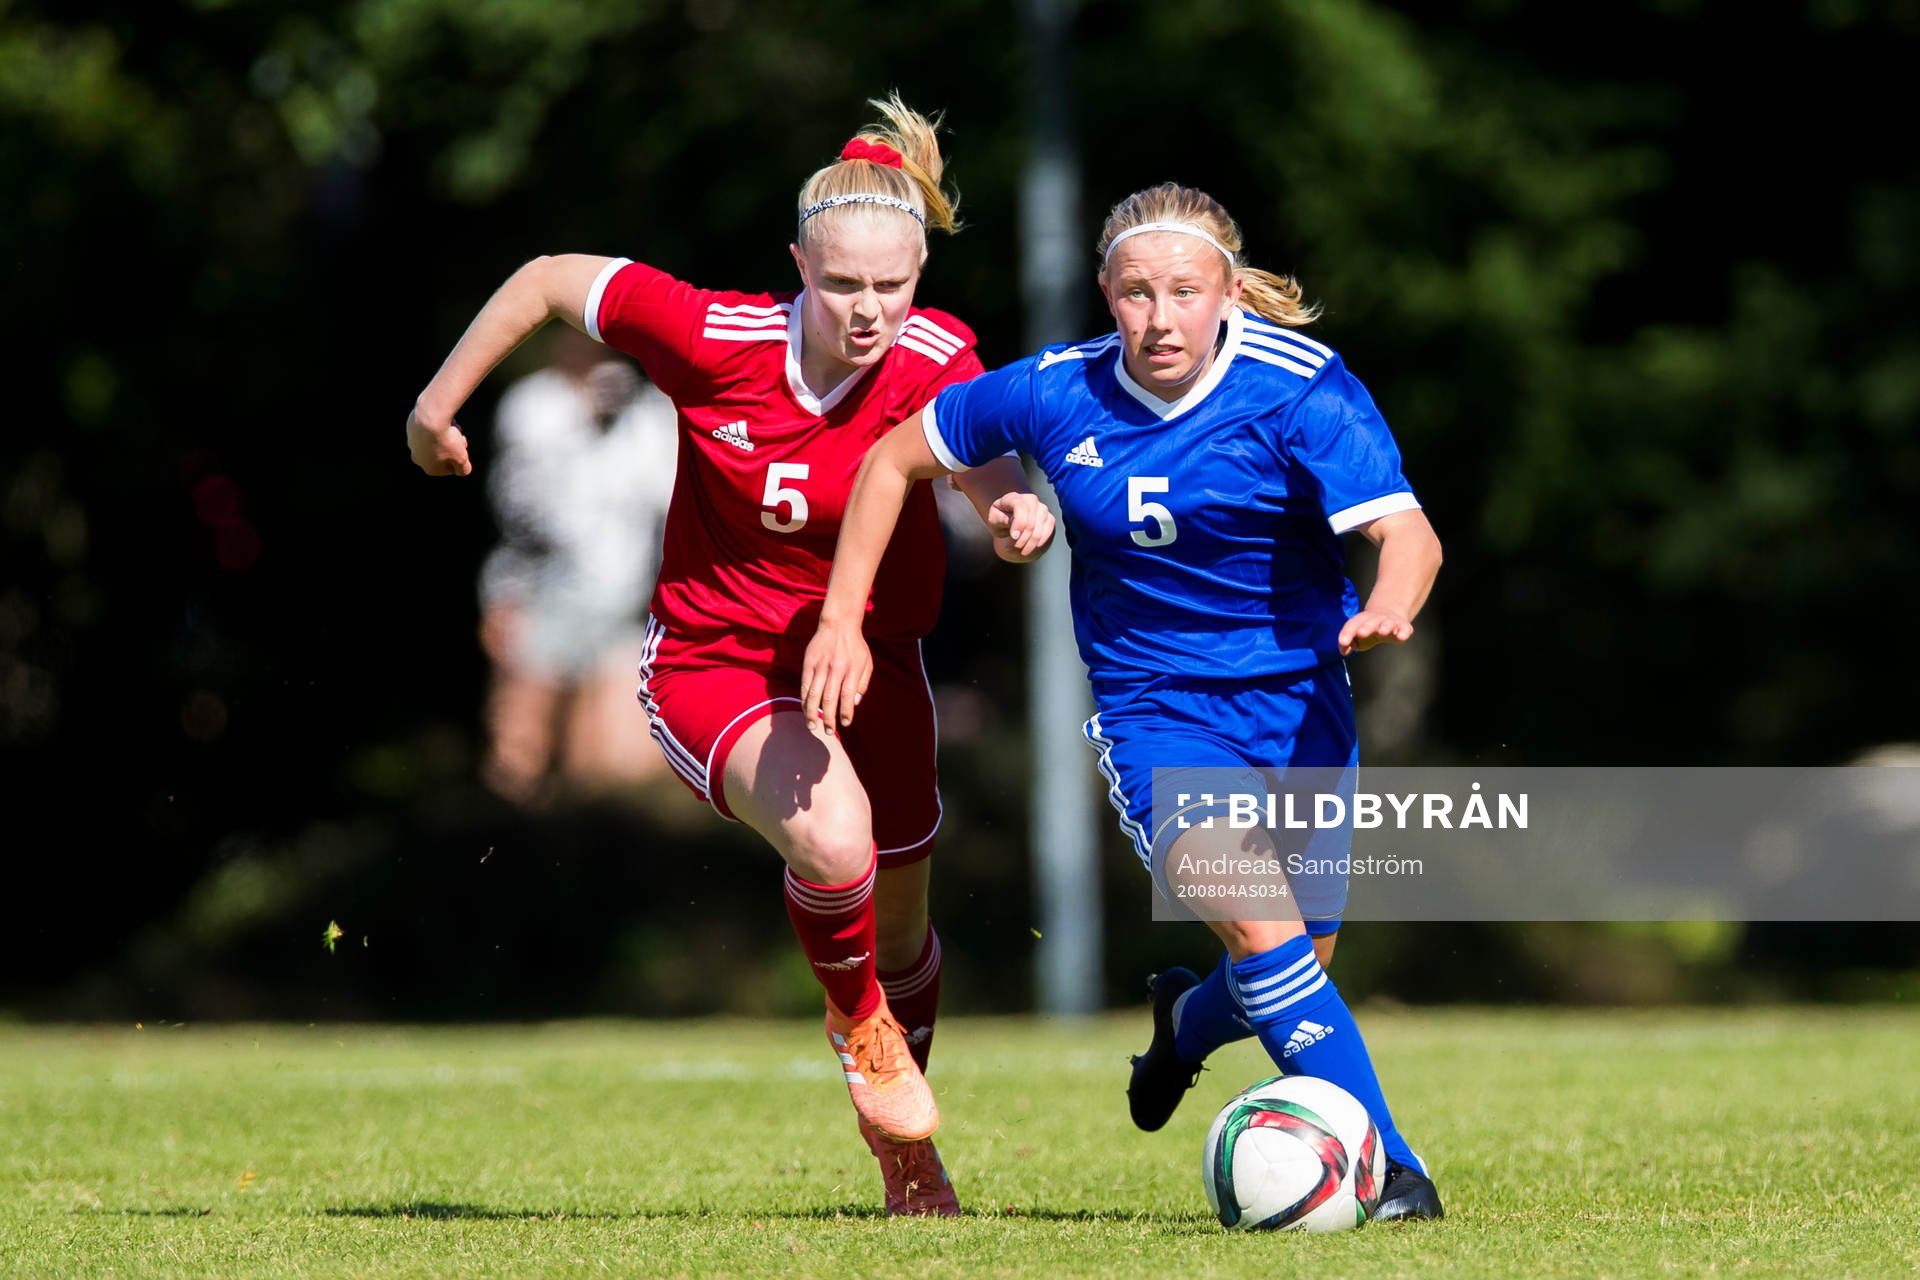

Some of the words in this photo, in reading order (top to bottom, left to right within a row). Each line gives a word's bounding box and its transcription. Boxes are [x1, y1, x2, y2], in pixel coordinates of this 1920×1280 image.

[712, 429, 755, 452] adidas
[1065, 452, 1104, 468] adidas
[760, 462, 810, 534] 5
[1127, 476, 1178, 548] 5
[1283, 1025, 1335, 1058] adidas
